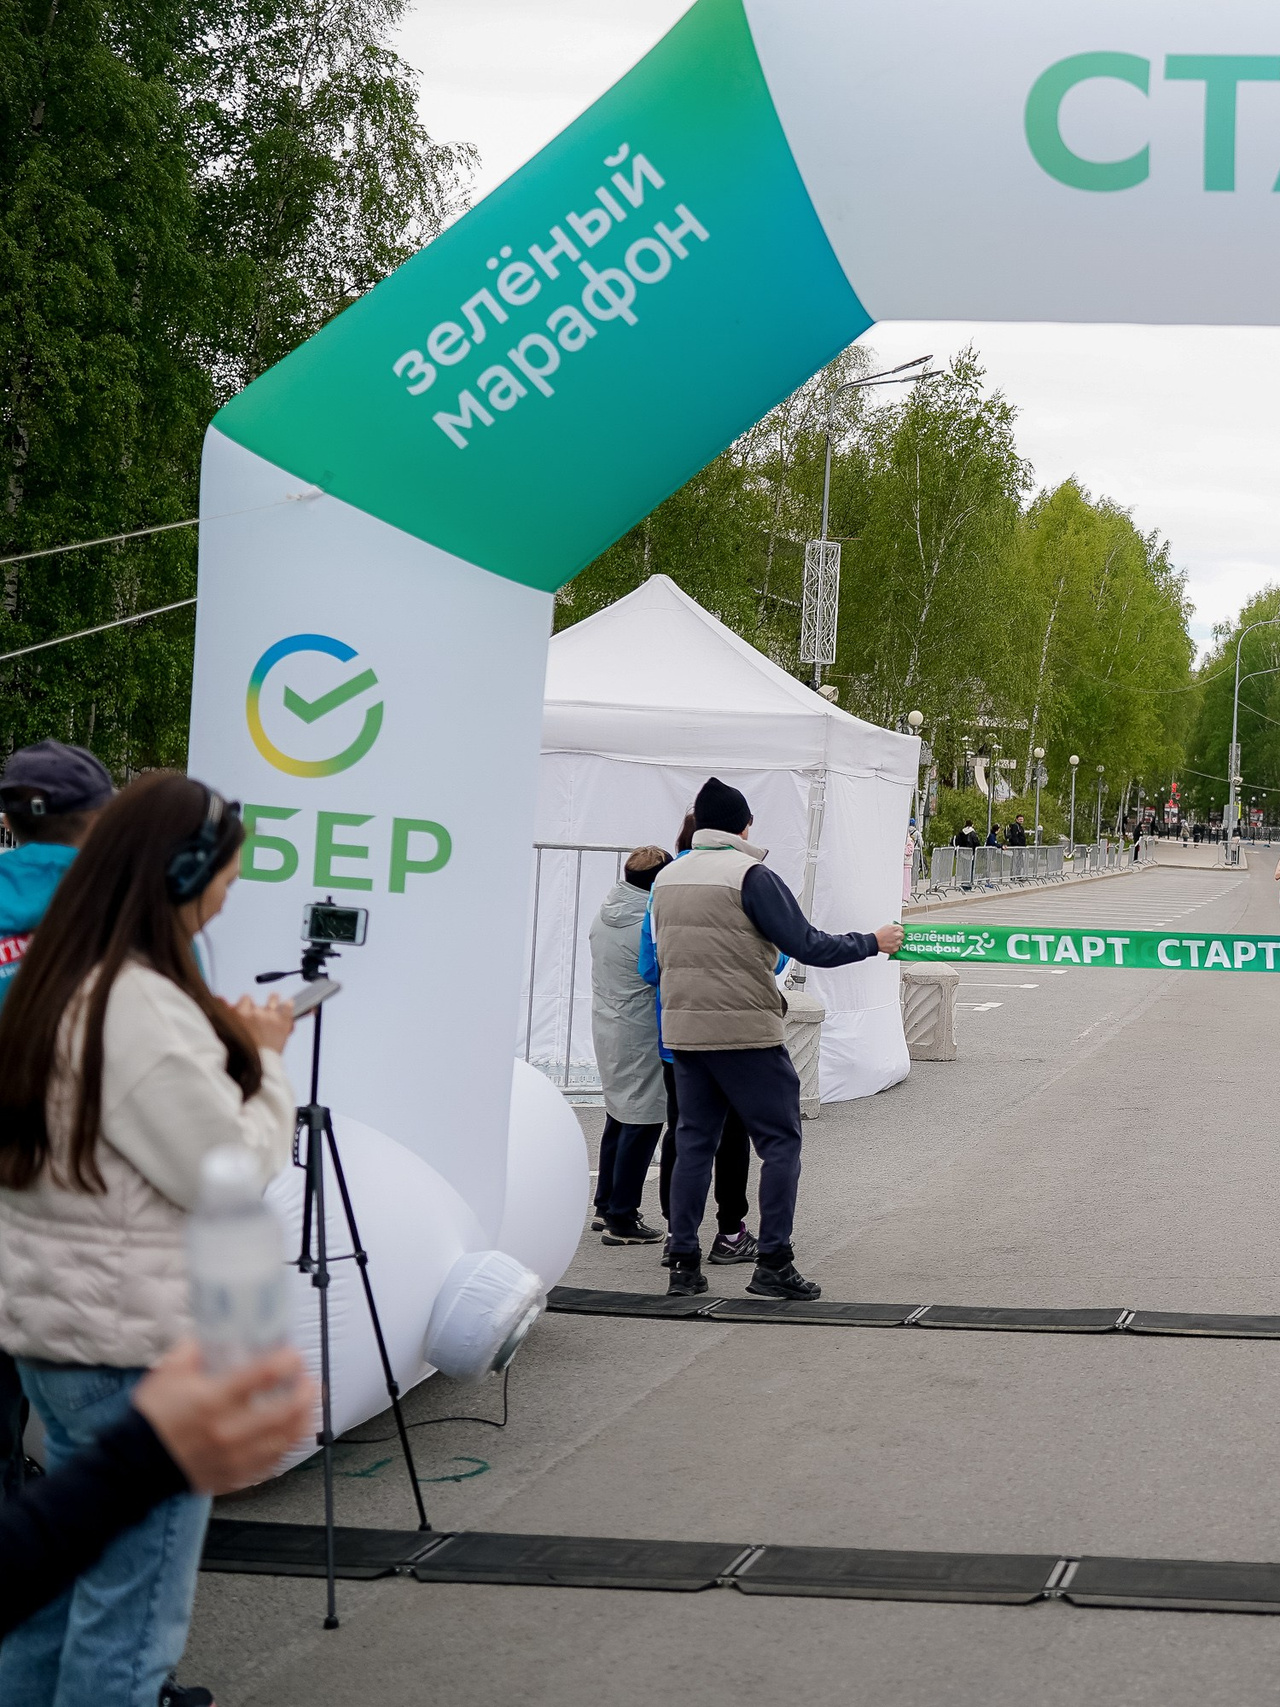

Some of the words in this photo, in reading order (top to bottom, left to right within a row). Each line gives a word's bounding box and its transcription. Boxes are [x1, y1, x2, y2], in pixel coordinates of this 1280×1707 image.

[392, 142, 666, 396] зелёный
[433, 203, 710, 450] марафон
[239, 804, 452, 893] БЕР
[901, 942, 961, 954] марафон
[906, 930, 966, 943] зелёный
[1006, 933, 1130, 965] СТАРТ
[1157, 938, 1280, 970] СТАРТ
